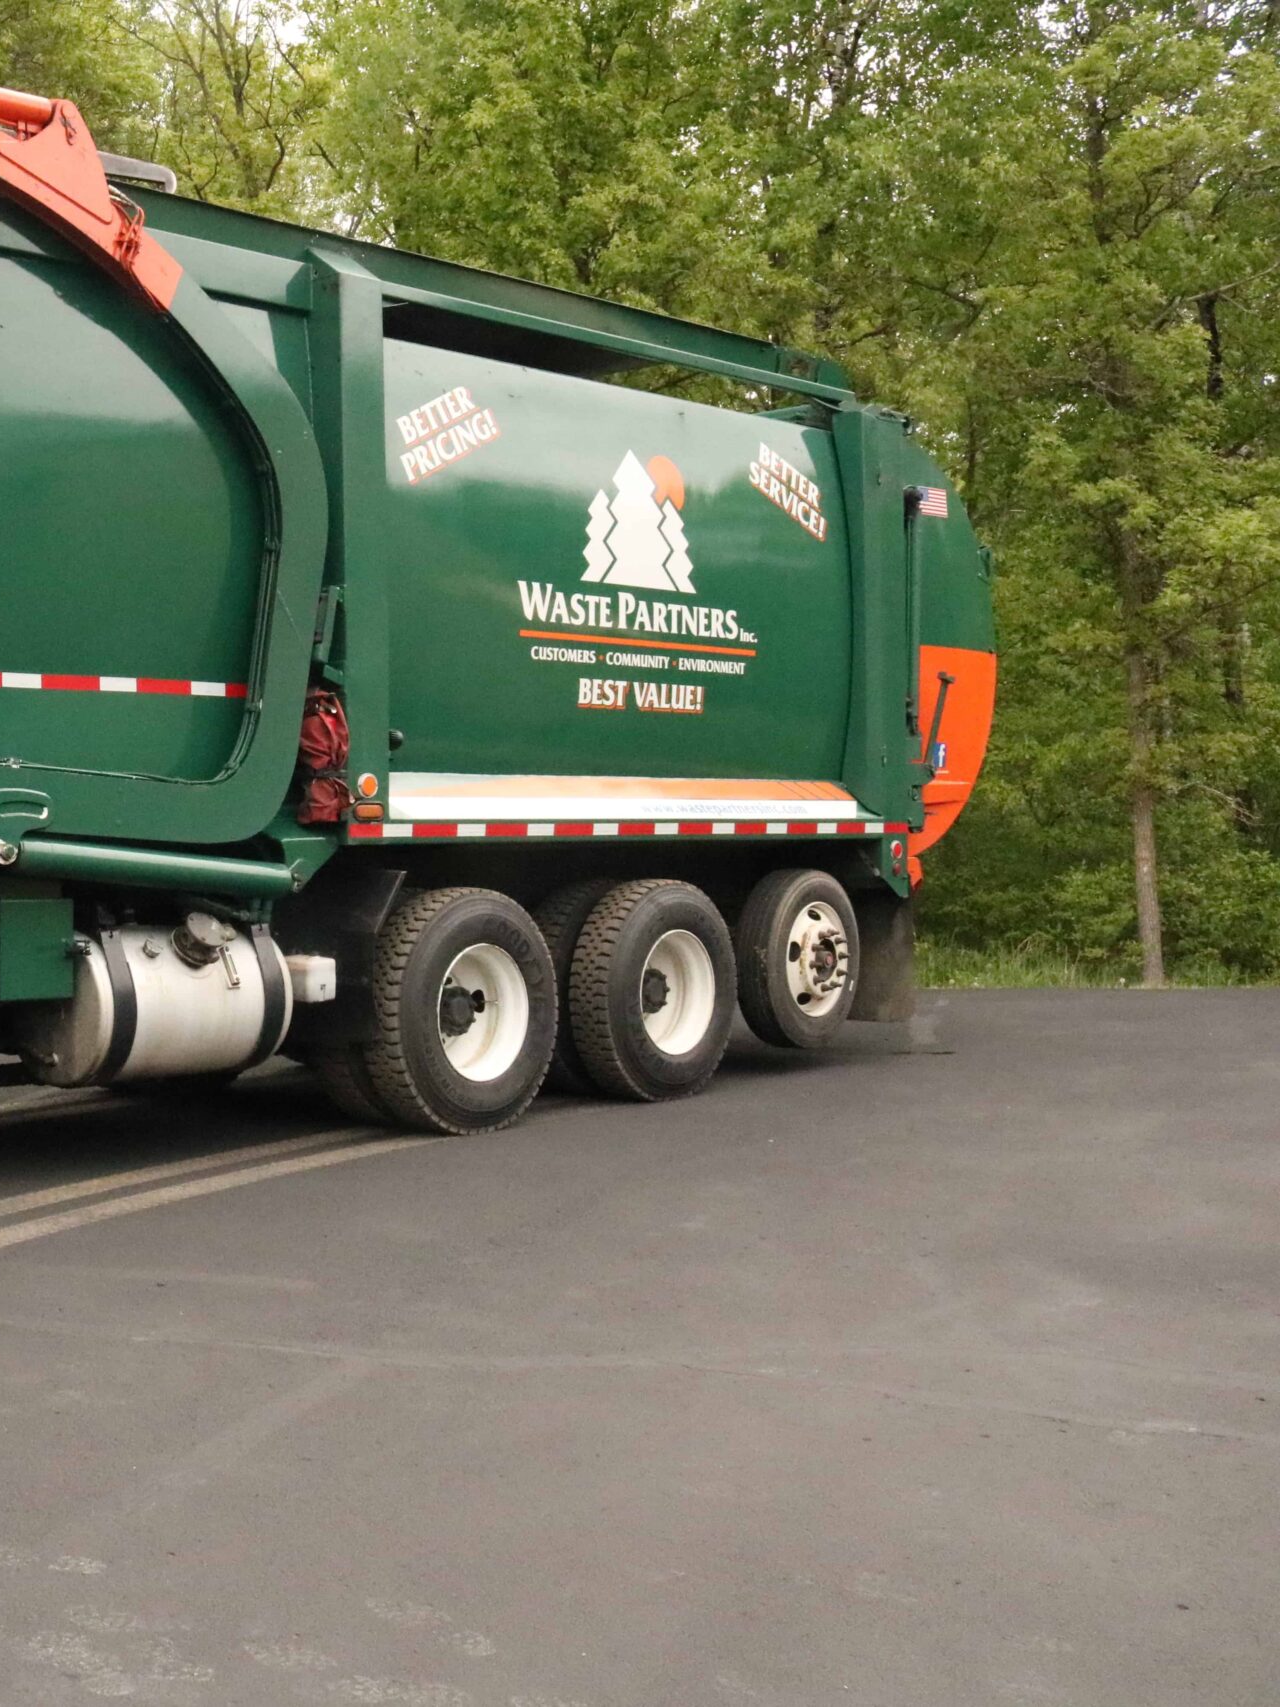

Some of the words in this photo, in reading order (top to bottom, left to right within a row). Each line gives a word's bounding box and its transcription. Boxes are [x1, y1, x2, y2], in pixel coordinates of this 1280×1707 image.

[395, 386, 479, 446] BETTER
[399, 408, 500, 484] PRICING!
[748, 461, 827, 542] SERVICE!
[758, 441, 821, 512] BETTER
[516, 579, 613, 629] WASTE
[617, 591, 739, 641] PARTNERS
[739, 627, 759, 644] Inc.
[530, 645, 597, 664] CUSTOMERS
[605, 651, 671, 670] COMMUNITY
[678, 657, 747, 676] ENVIRONMENT
[577, 677, 630, 709] BEST
[632, 681, 704, 712] VALUE!
